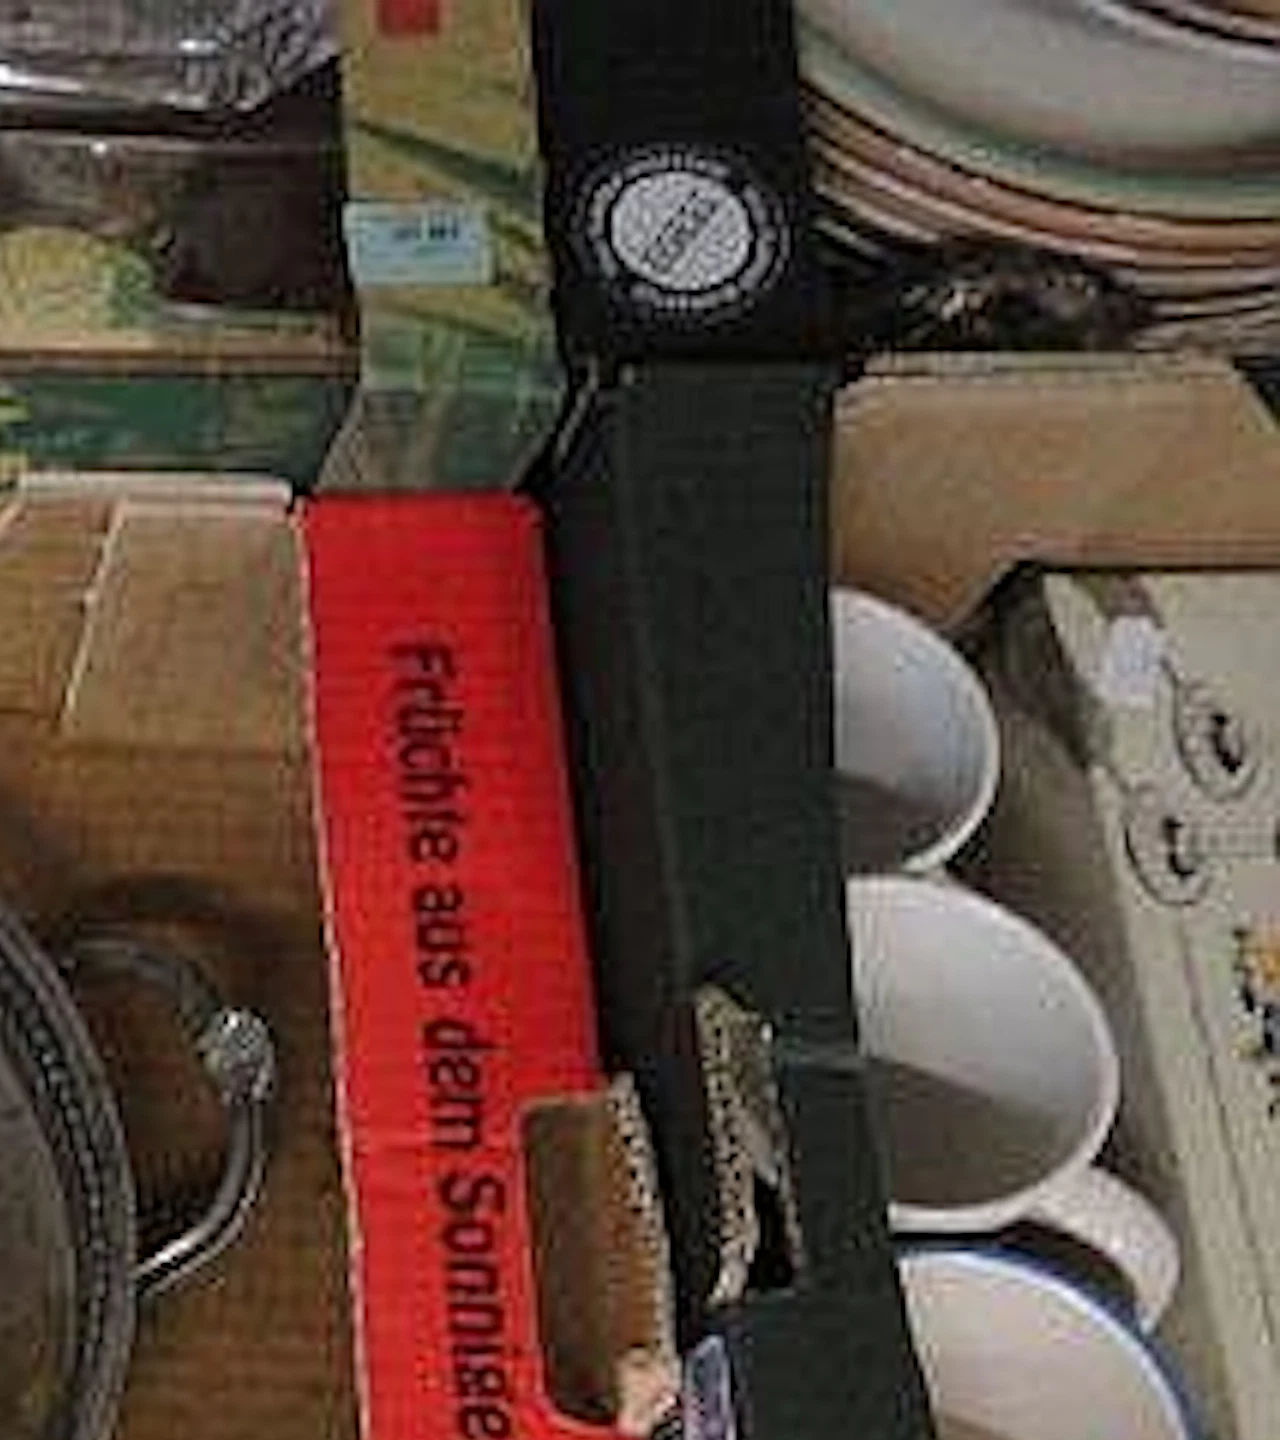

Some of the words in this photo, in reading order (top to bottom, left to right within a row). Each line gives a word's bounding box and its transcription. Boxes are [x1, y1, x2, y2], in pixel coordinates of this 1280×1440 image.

[385, 640, 465, 866] Früchte
[412, 885, 473, 991] aus
[419, 1016, 496, 1149] dem
